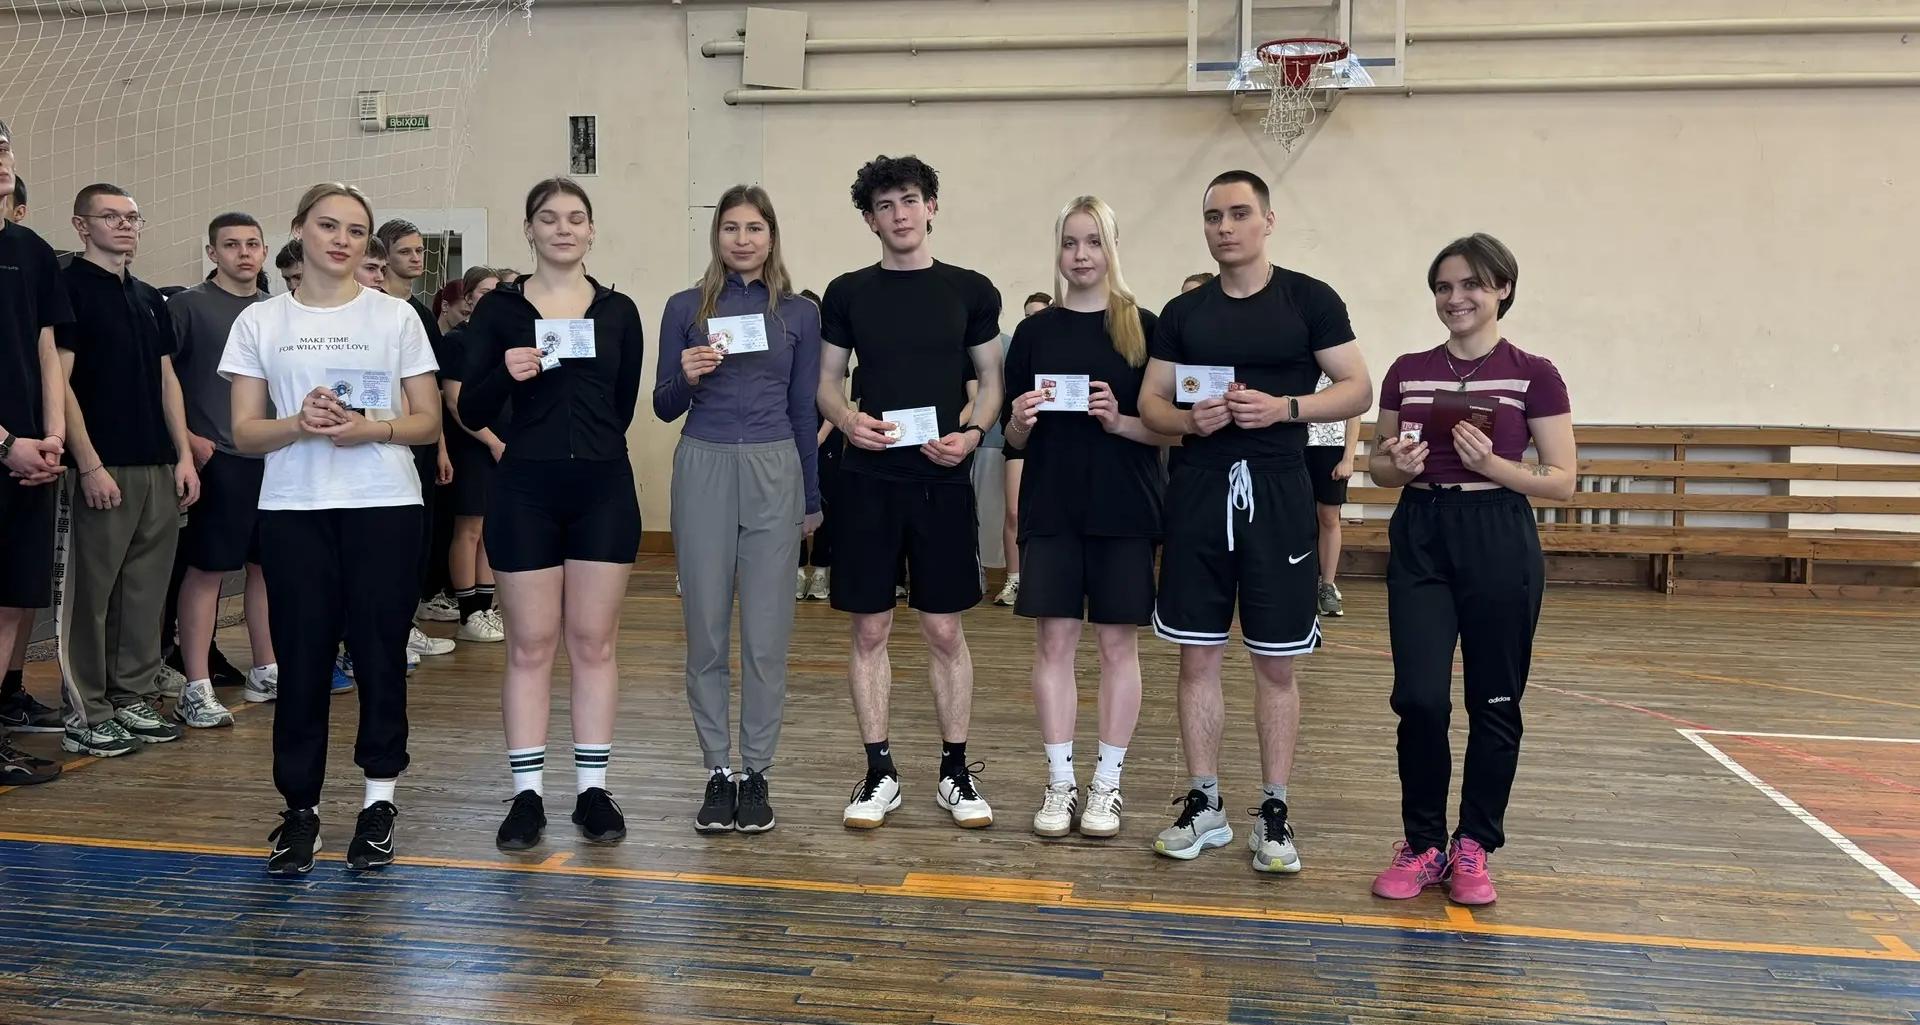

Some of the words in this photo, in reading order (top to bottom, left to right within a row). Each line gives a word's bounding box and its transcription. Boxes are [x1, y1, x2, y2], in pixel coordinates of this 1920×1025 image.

[390, 118, 424, 127] ВЫХОД
[279, 345, 294, 353] FOR
[346, 343, 370, 351] LOVE
[1488, 696, 1511, 704] adidas
